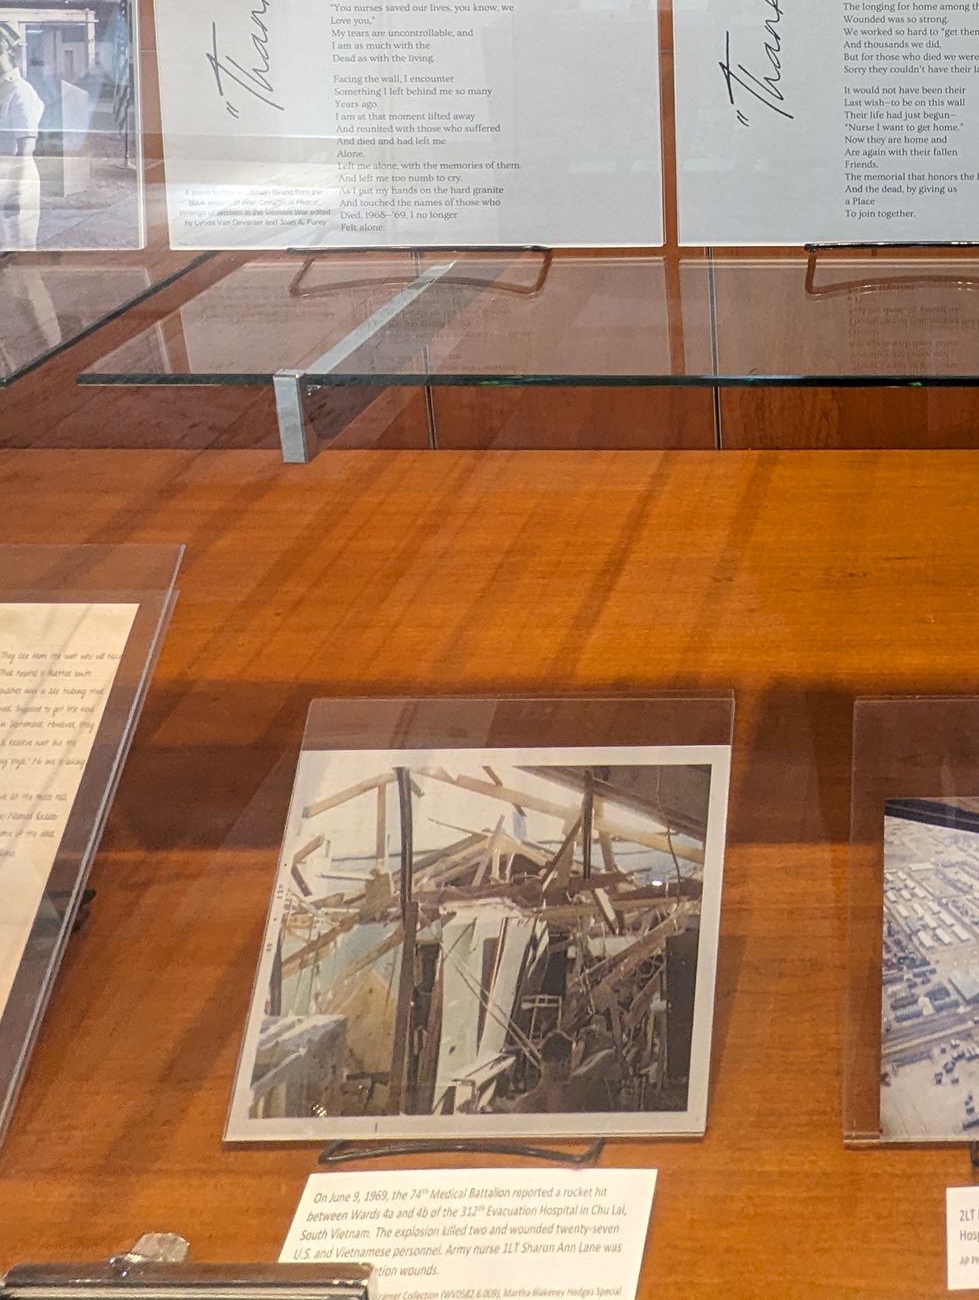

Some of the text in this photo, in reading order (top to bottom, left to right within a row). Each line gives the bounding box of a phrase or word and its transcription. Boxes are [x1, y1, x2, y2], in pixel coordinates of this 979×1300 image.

[313, 1192, 328, 1204] On
[328, 1192, 351, 1204] June
[391, 1189, 408, 1201] the
[429, 1187, 468, 1200] Medical
[468, 1187, 511, 1199] Battalion
[511, 1186, 554, 1200] reported
[555, 1188, 561, 1197] a
[562, 1186, 593, 1198] rocket
[594, 1187, 608, 1197] hit
[306, 1210, 349, 1223] between
[350, 1208, 381, 1220] Wards
[382, 1208, 395, 1219] 4a
[395, 1206, 416, 1219] and
[415, 1207, 429, 1219] 4b
[430, 1205, 442, 1218] of
[442, 1206, 459, 1218] the
[486, 1204, 538, 1217] Evacuation
[539, 1204, 579, 1218] Hospital
[579, 1205, 589, 1215] in
[591, 1204, 610, 1216] Chu
[959, 1208, 976, 1222] 2LT
